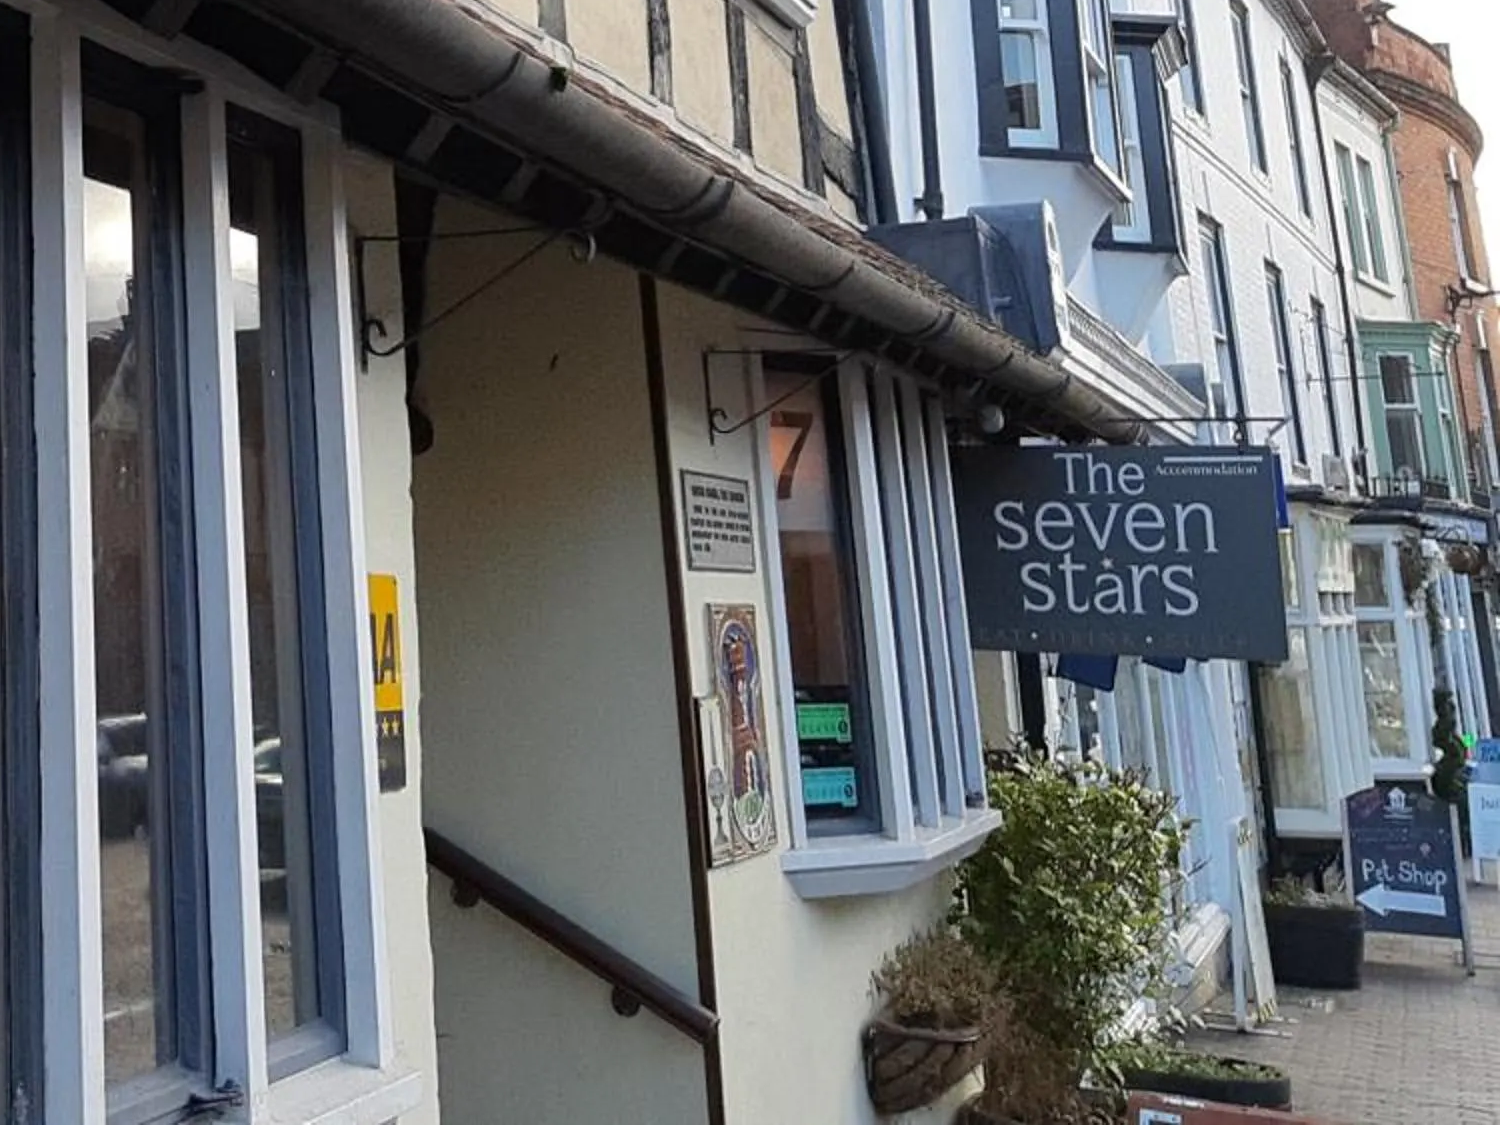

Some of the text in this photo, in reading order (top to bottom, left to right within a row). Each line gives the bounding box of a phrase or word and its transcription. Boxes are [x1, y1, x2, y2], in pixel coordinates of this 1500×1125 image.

[1053, 452, 1145, 495] The
[1155, 463, 1257, 476] Accommodation
[993, 500, 1219, 553] seven
[1020, 551, 1199, 616] stars
[1361, 858, 1447, 895] Pet Shop
